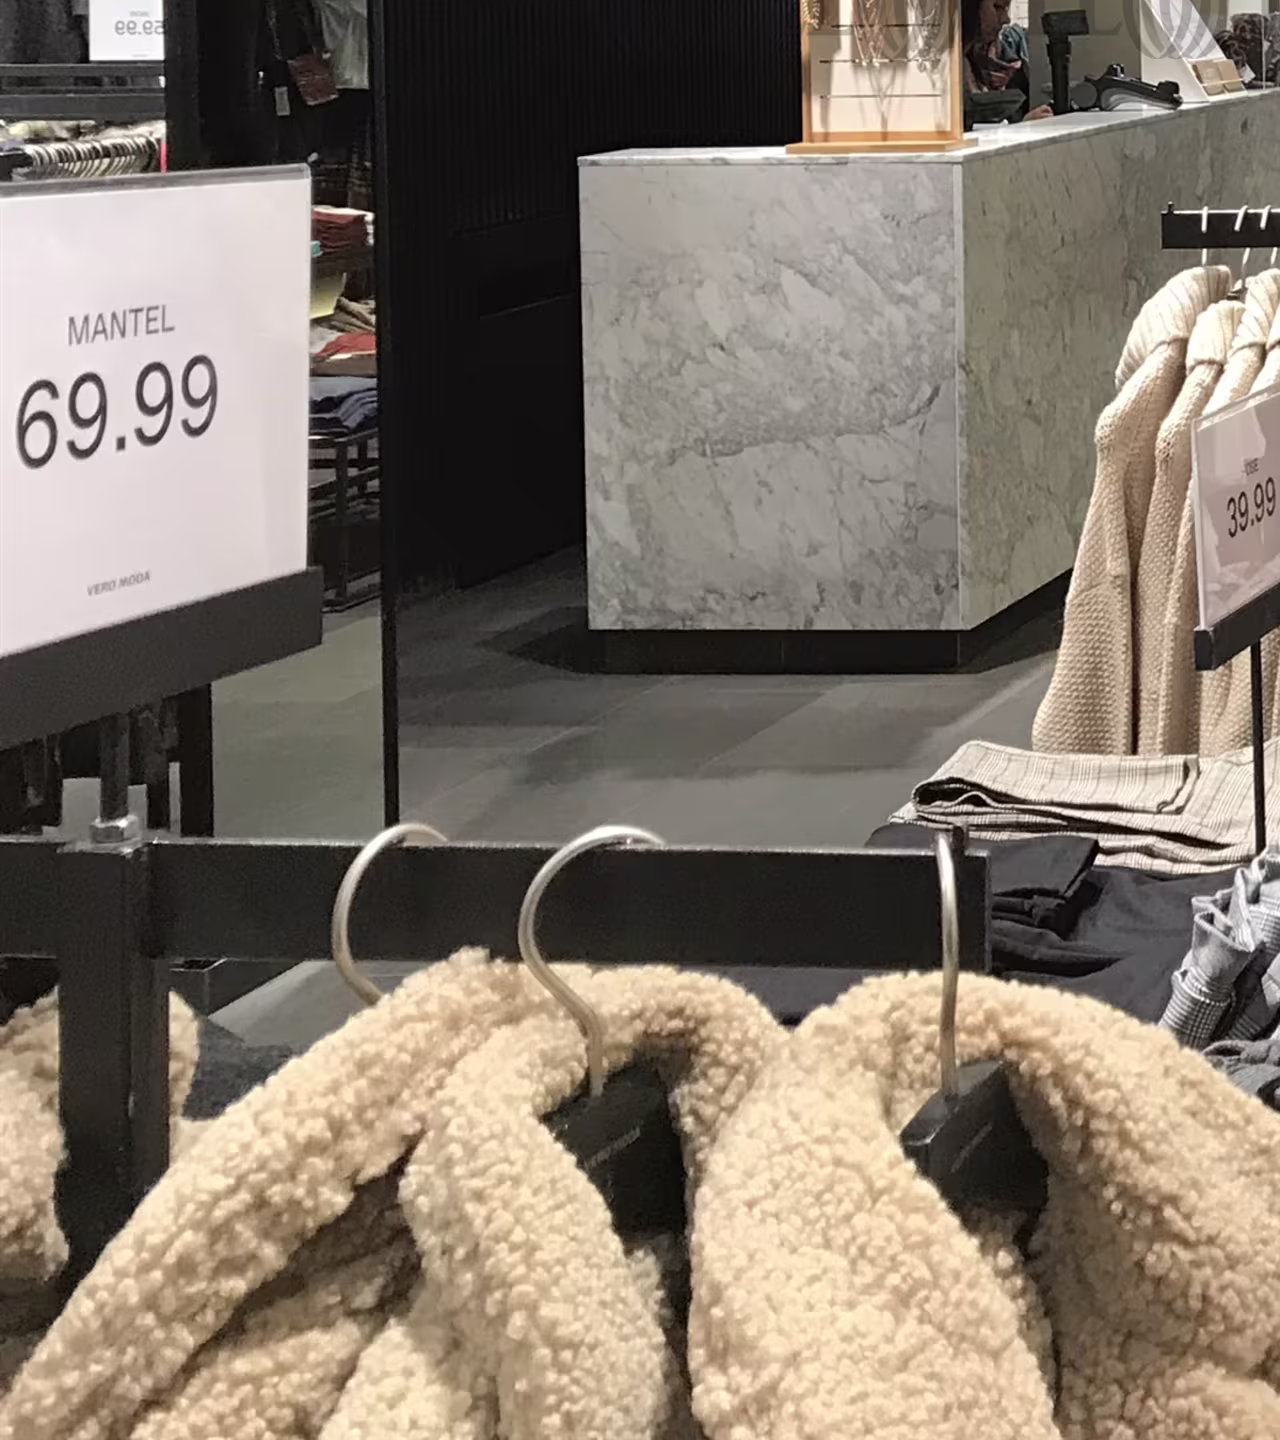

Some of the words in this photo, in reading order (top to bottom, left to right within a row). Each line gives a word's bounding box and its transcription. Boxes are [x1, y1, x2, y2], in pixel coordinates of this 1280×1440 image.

[68, 304, 175, 346] MANTEL
[15, 353, 219, 470] 69.99
[1226, 476, 1277, 539] 39.99
[86, 579, 116, 597] VERO
[118, 570, 151, 589] MODA
